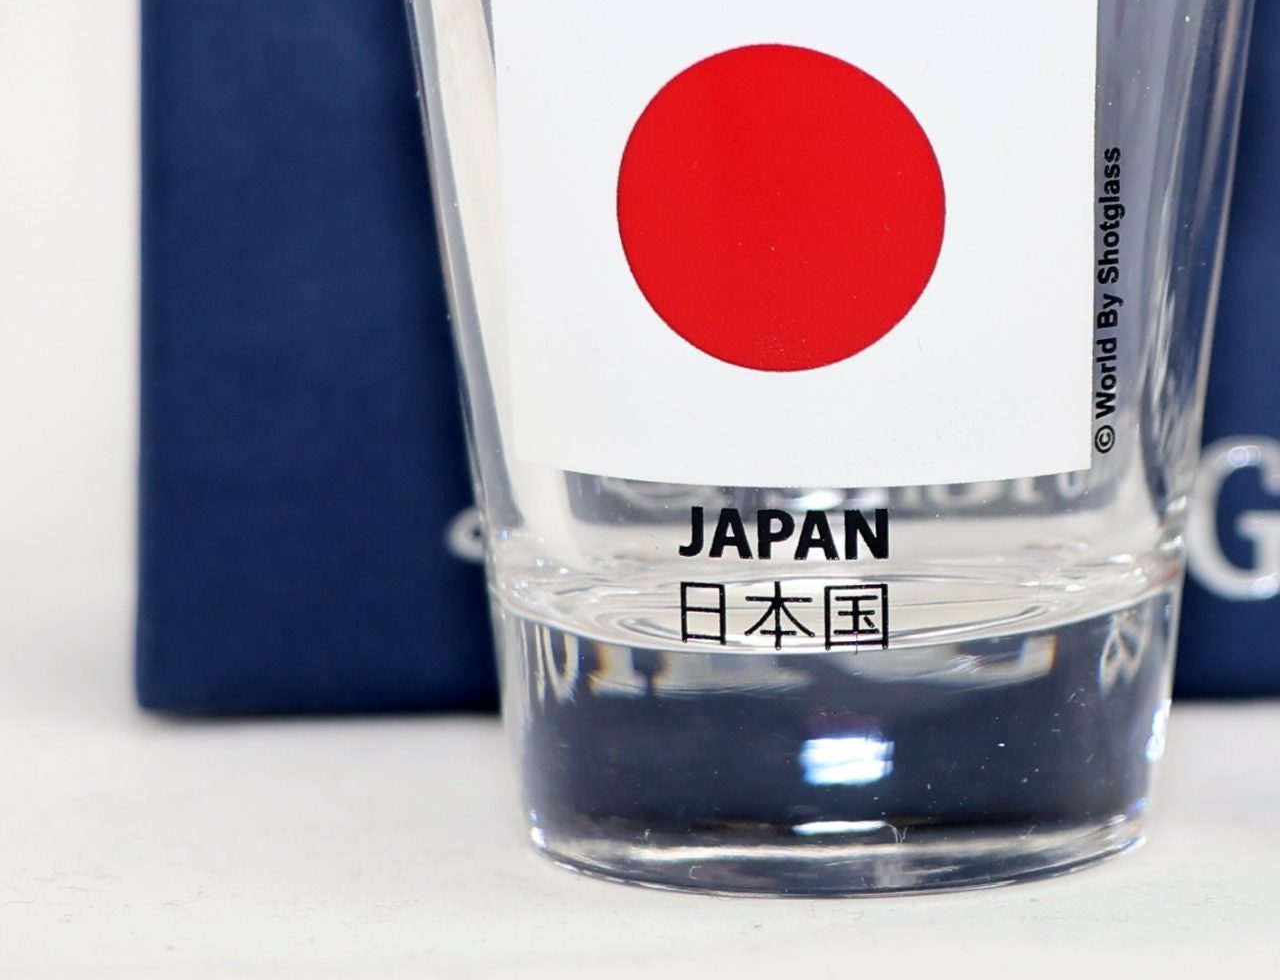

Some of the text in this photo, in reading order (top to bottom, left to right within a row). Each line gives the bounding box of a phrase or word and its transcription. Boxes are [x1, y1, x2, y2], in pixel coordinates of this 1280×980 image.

[1097, 146, 1126, 284] Shotglass
[1096, 292, 1125, 329] By
[1095, 337, 1117, 419] World
[679, 505, 890, 561] JAPAN
[680, 581, 889, 650] 日本国
